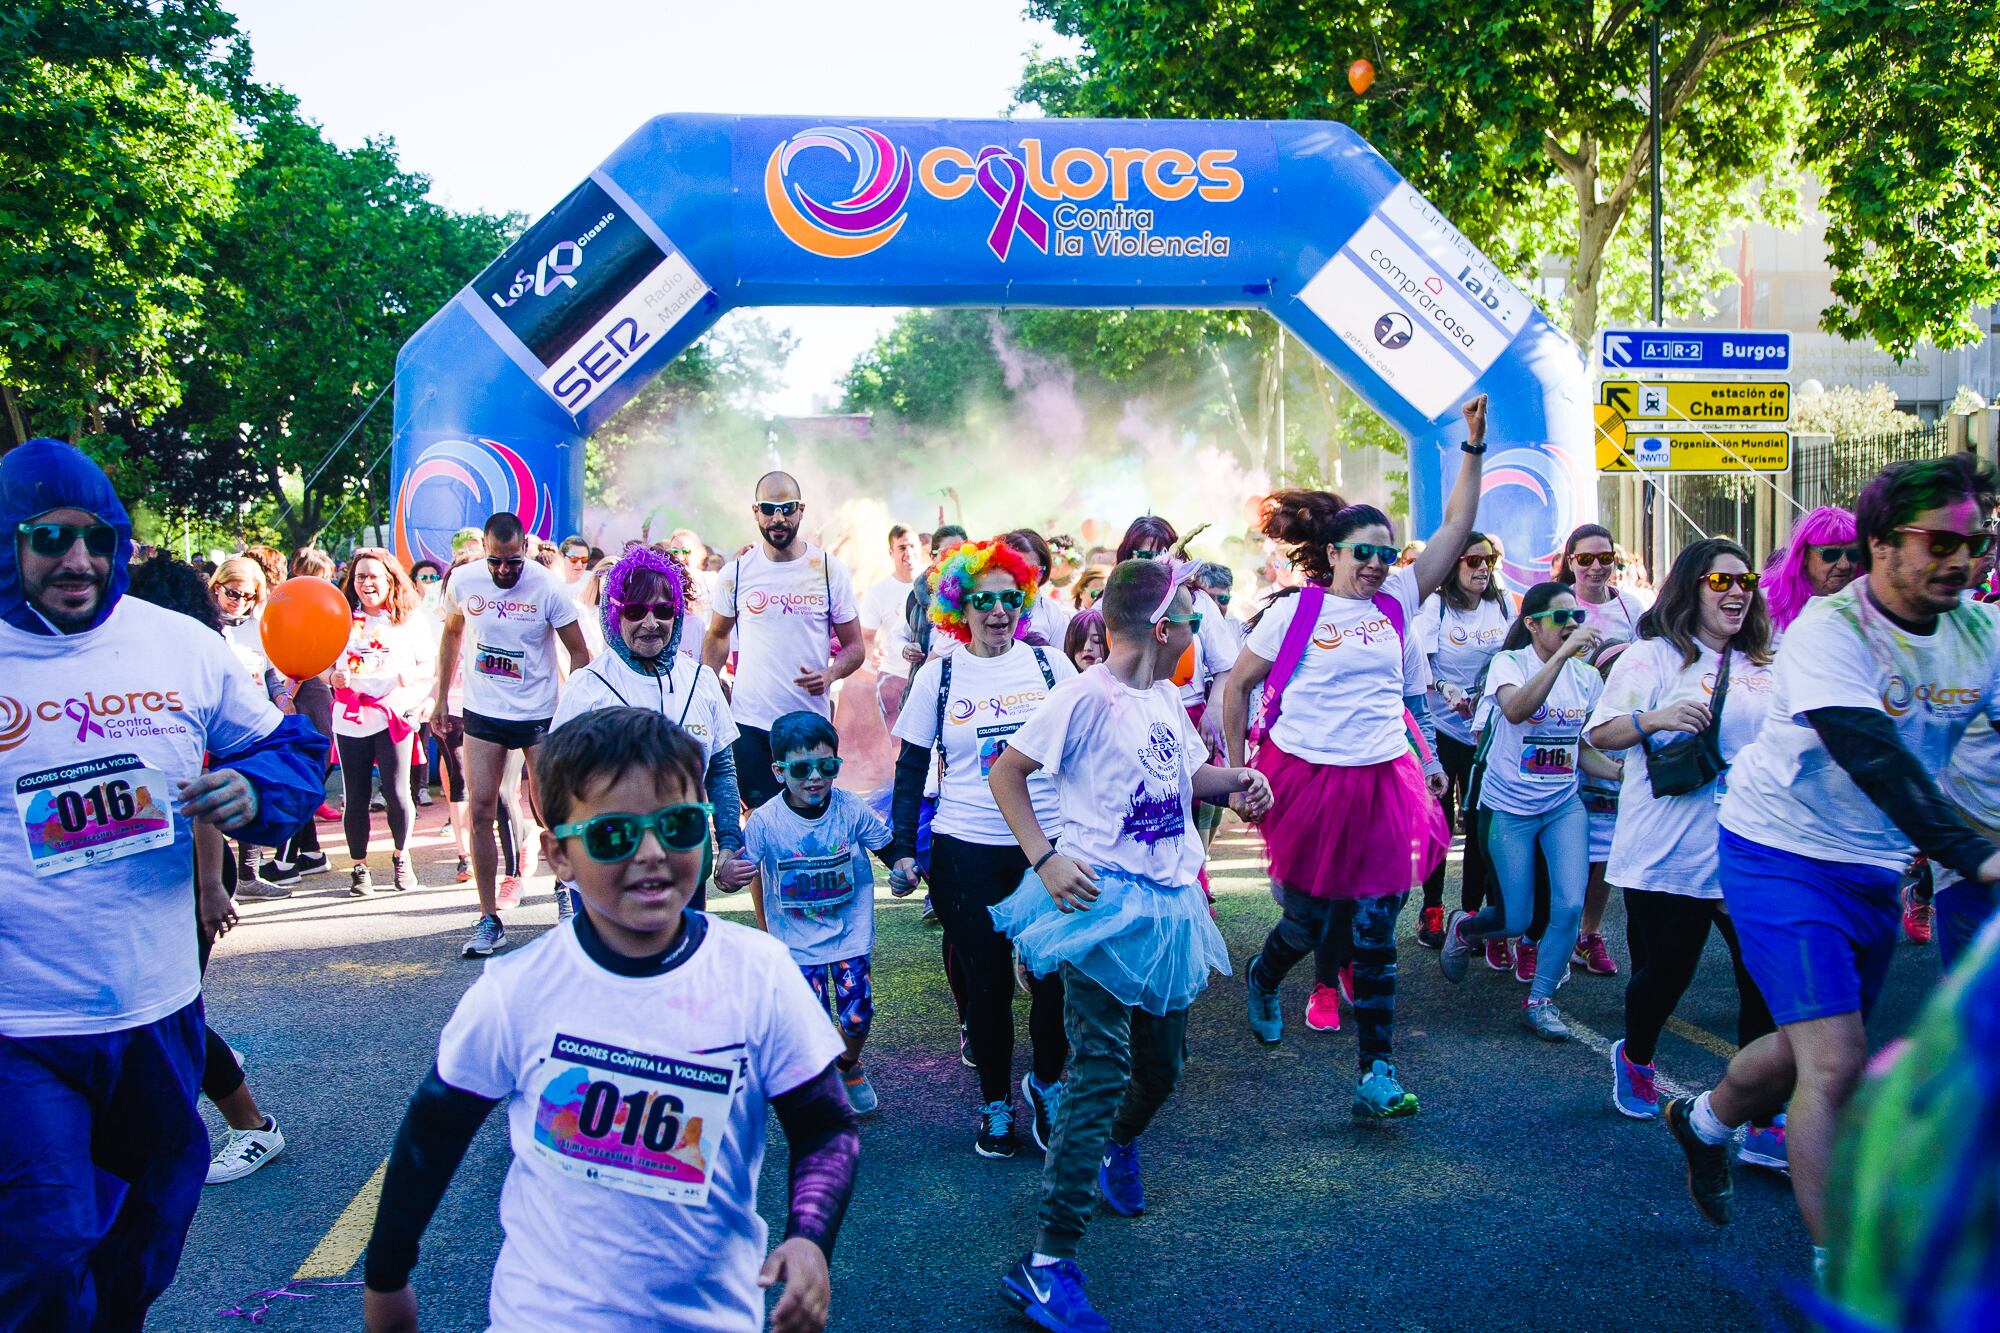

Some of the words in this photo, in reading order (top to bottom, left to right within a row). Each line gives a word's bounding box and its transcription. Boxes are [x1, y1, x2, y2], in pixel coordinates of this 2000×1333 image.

[1053, 203, 1153, 231] Contra
[577, 212, 616, 247] Classic
[1055, 231, 1083, 256] la
[1092, 231, 1230, 257] Violencia
[1408, 194, 1511, 295] cumlaude
[644, 271, 684, 309] Radio
[657, 279, 703, 324] Madrid
[1722, 341, 1787, 361] Burgos
[1711, 388, 1767, 398] estación
[1769, 388, 1785, 398] de
[1690, 401, 1784, 417] Chamartín
[1742, 439, 1784, 448] Mundial
[1636, 453, 1669, 463] UNWTO
[1741, 455, 1784, 464] Turismo
[486, 655, 512, 671] 016
[105, 717, 152, 729] Contra
[108, 729, 122, 739] la
[128, 724, 187, 738] Violencia
[1536, 748, 1566, 767] 016
[19, 773, 58, 787] COLORES
[60, 766, 96, 779] CONTRA
[96, 762, 108, 771] LA
[56, 779, 136, 833] 016
[558, 1040, 608, 1062] COLORES
[610, 1052, 655, 1072] CONTRA
[657, 1062, 672, 1075] LA
[674, 1065, 728, 1086] VIOLENCIA
[578, 1080, 684, 1153] 016
